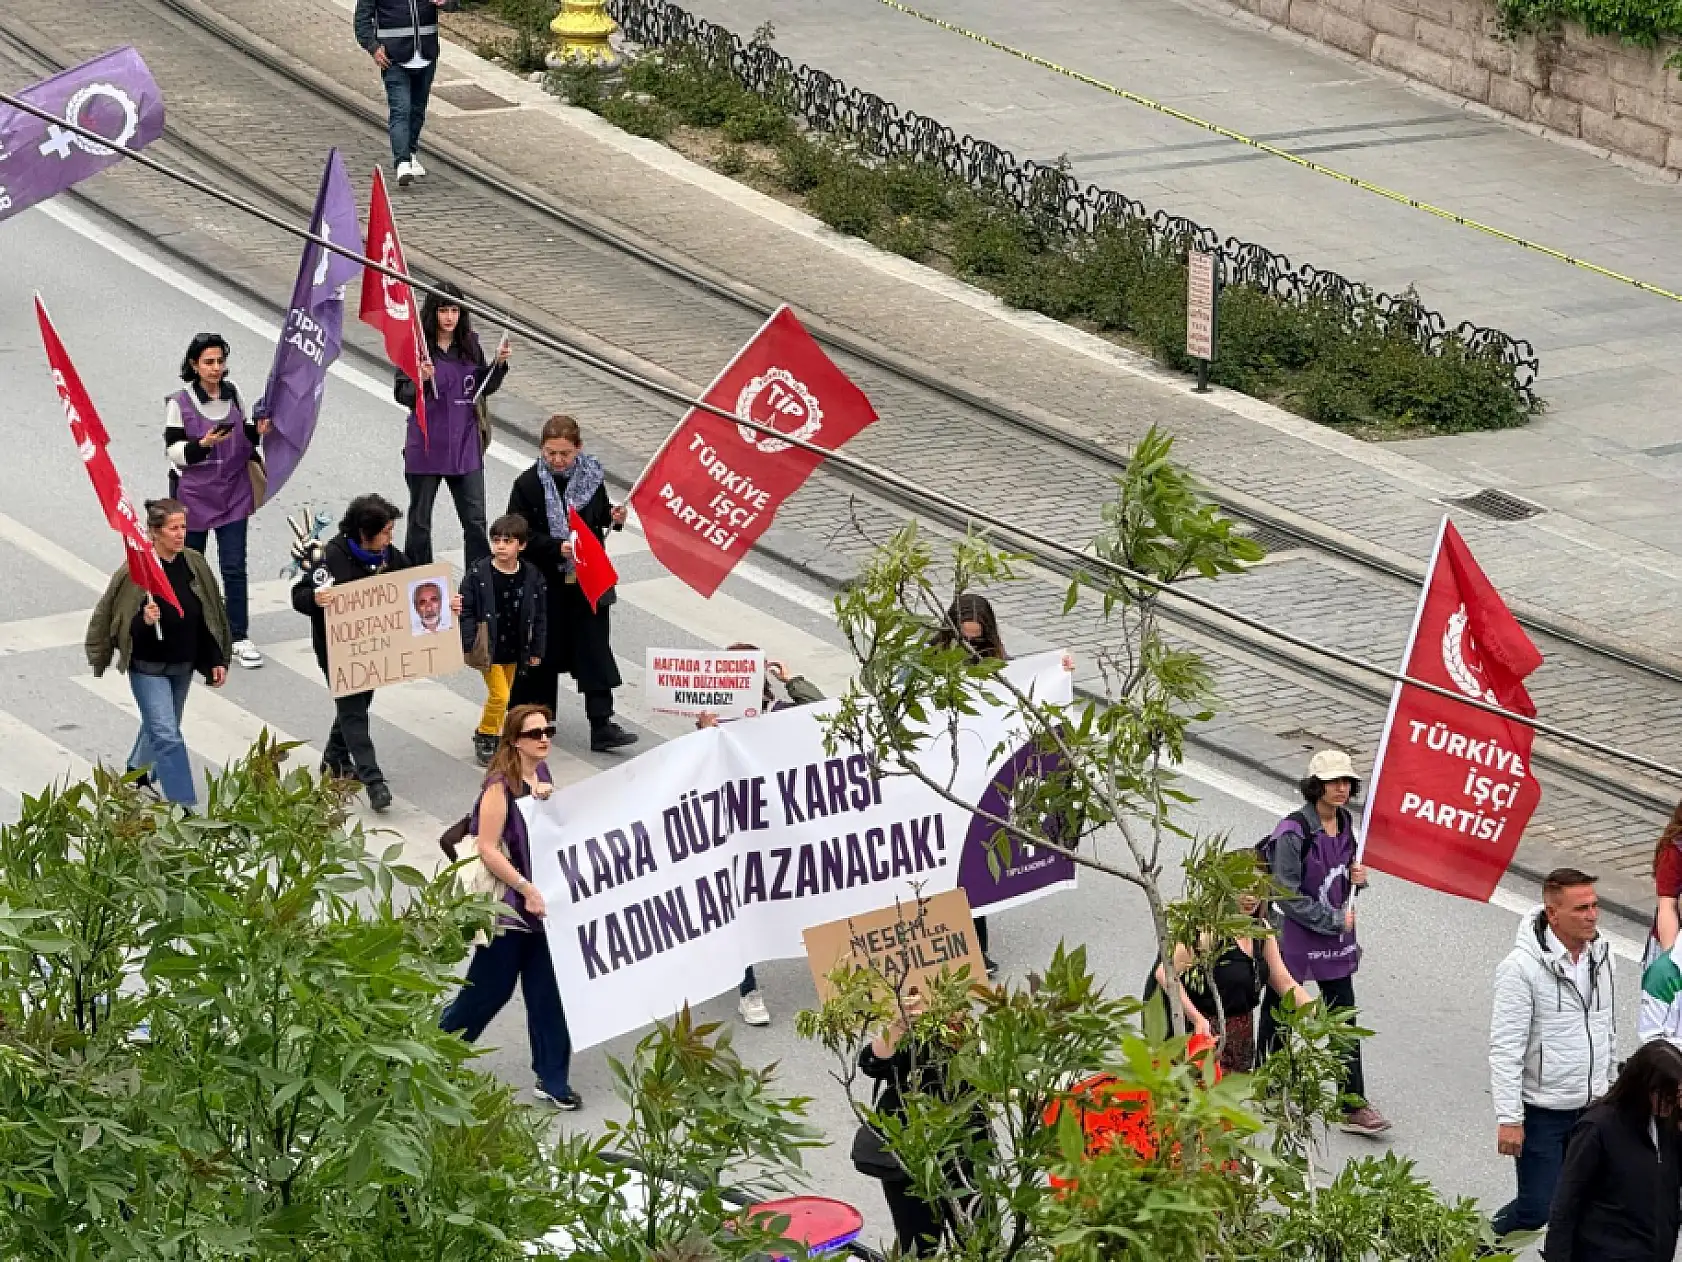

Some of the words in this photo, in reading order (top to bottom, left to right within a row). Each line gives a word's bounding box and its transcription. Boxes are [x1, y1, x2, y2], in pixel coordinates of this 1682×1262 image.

[766, 382, 805, 417] TİP
[688, 431, 771, 511] TÜRKİYE
[659, 481, 739, 552] PARTİSİ
[708, 490, 759, 530] İŞÇİ
[330, 610, 404, 647] NOURTANI
[335, 647, 439, 693] ADALET
[653, 656, 700, 672] HAFTADA
[704, 659, 712, 673] 2
[658, 673, 690, 689] KIYAN
[1408, 719, 1526, 778] TÜRKİYE
[1462, 766, 1521, 812] İŞÇİ
[1400, 792, 1507, 843] PARTİSİ
[557, 820, 658, 903] KARA
[577, 866, 737, 980] KADINLAR
[732, 812, 947, 908] AZANACAK!
